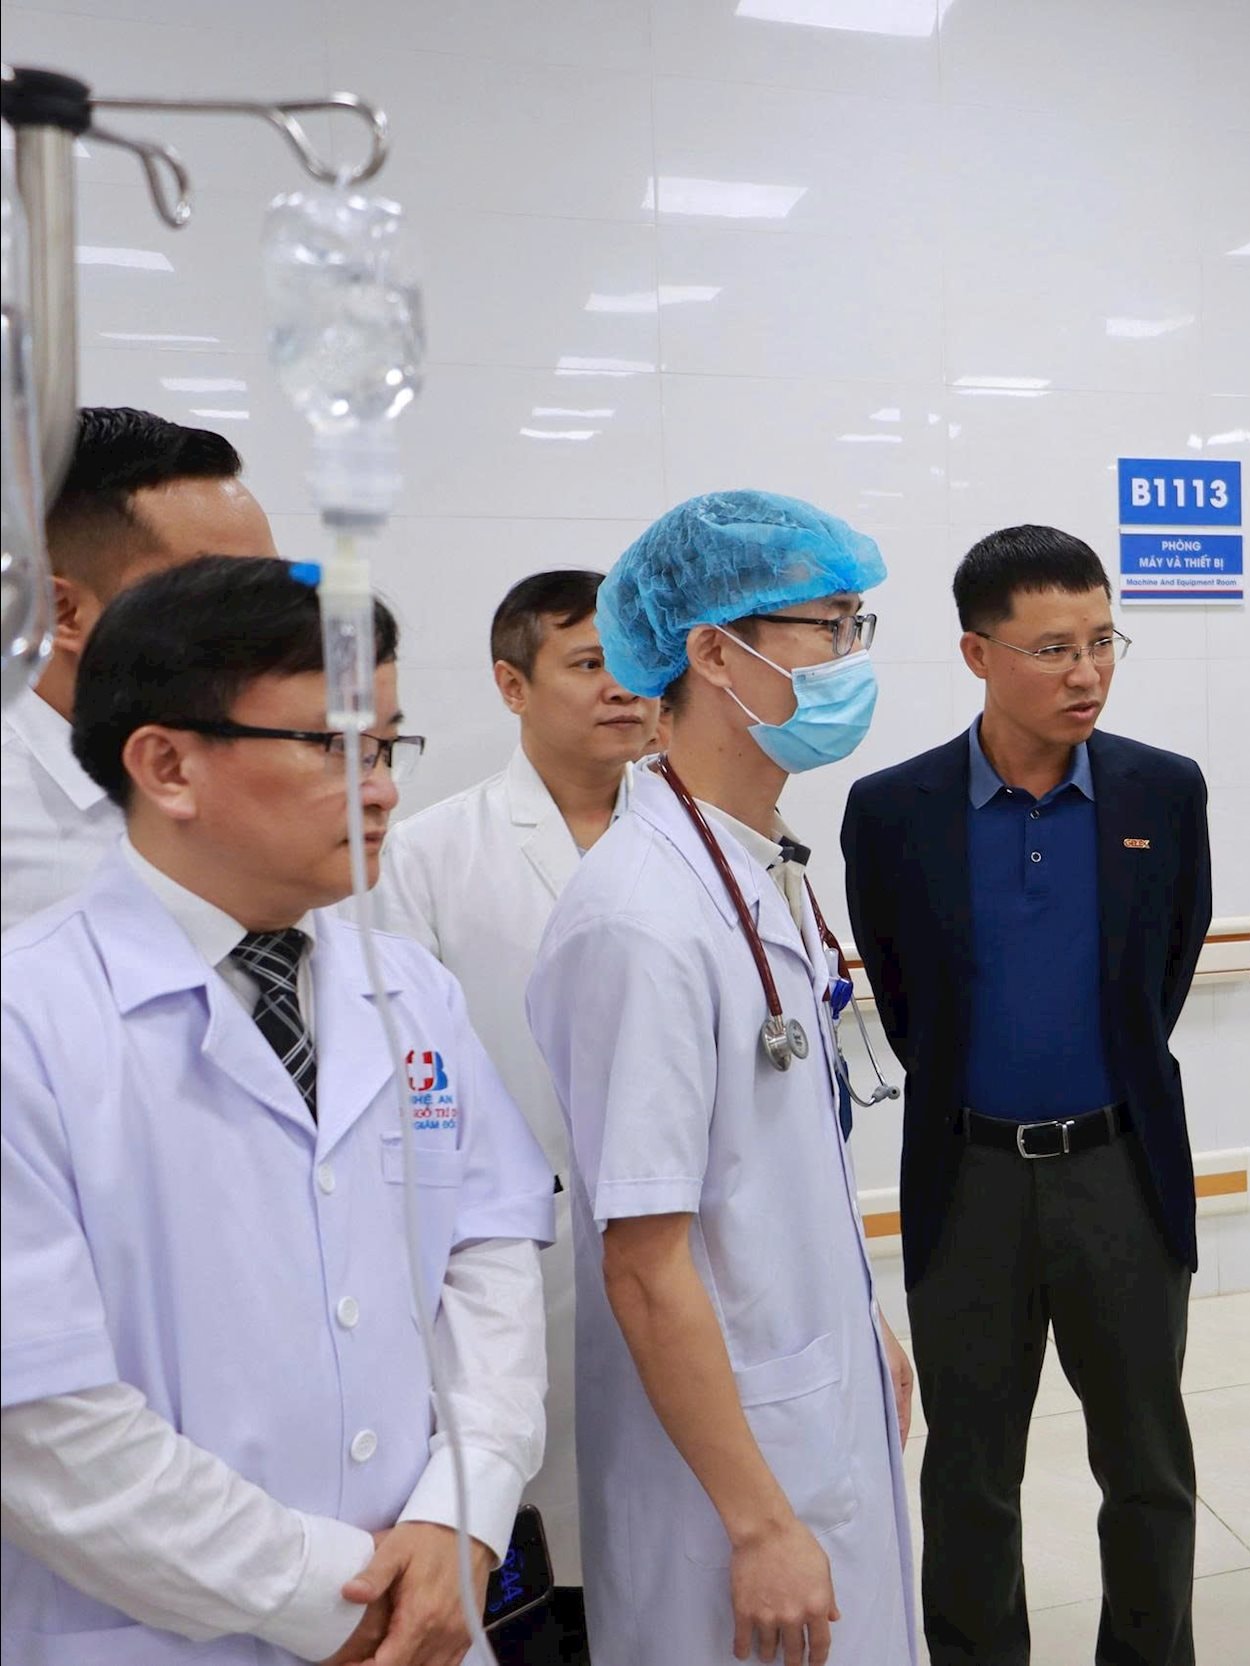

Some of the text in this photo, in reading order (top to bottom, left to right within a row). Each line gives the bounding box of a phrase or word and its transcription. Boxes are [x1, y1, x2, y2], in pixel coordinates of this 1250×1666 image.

[1131, 478, 1228, 508] B1113
[1162, 539, 1201, 551] PHÒNG
[1139, 554, 1224, 570] MÁY VÀ THIẾT BỊ
[1126, 578, 1237, 587] Machine And Equipment Room
